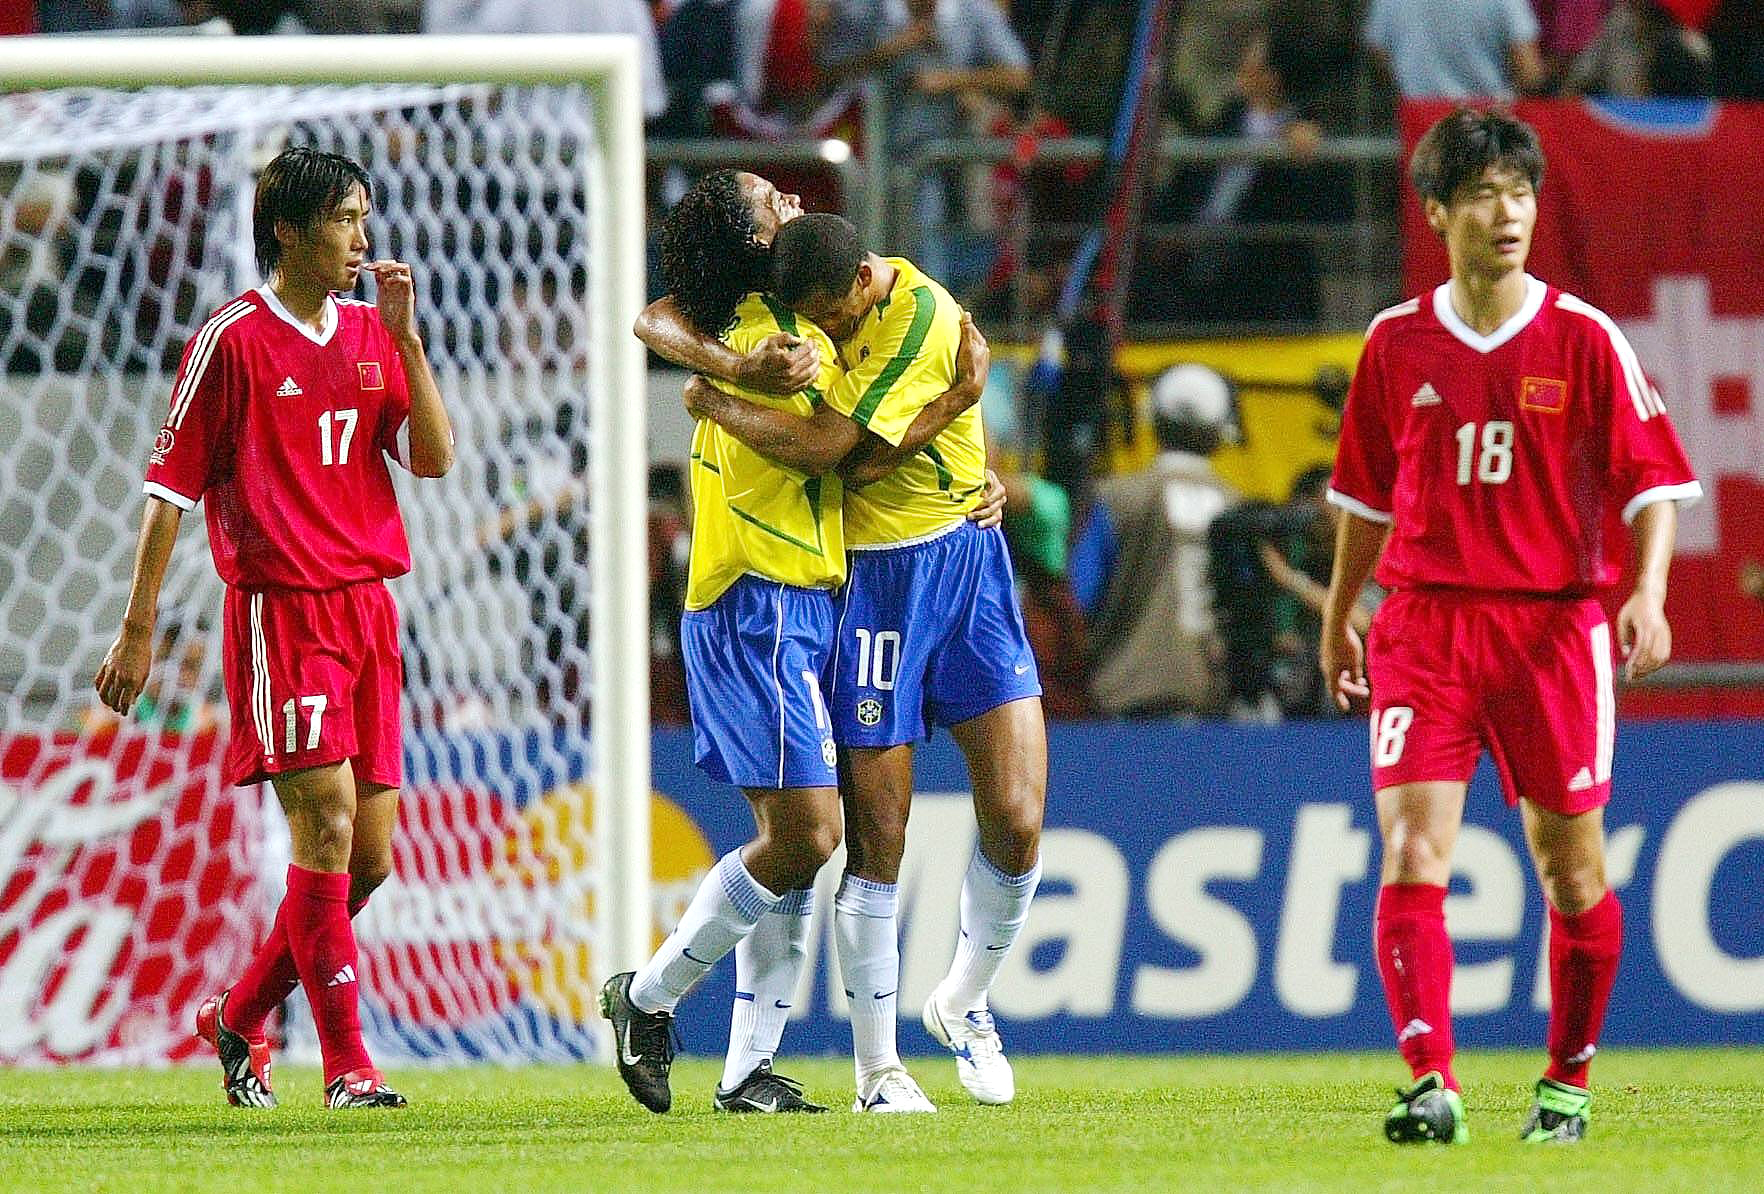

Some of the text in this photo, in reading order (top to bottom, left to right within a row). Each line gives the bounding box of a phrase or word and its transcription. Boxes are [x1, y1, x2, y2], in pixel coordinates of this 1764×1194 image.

[318, 408, 359, 466] 17
[1456, 420, 1515, 486] 18
[855, 628, 901, 691] 10
[282, 694, 328, 753] 17
[801, 670, 833, 736] 1
